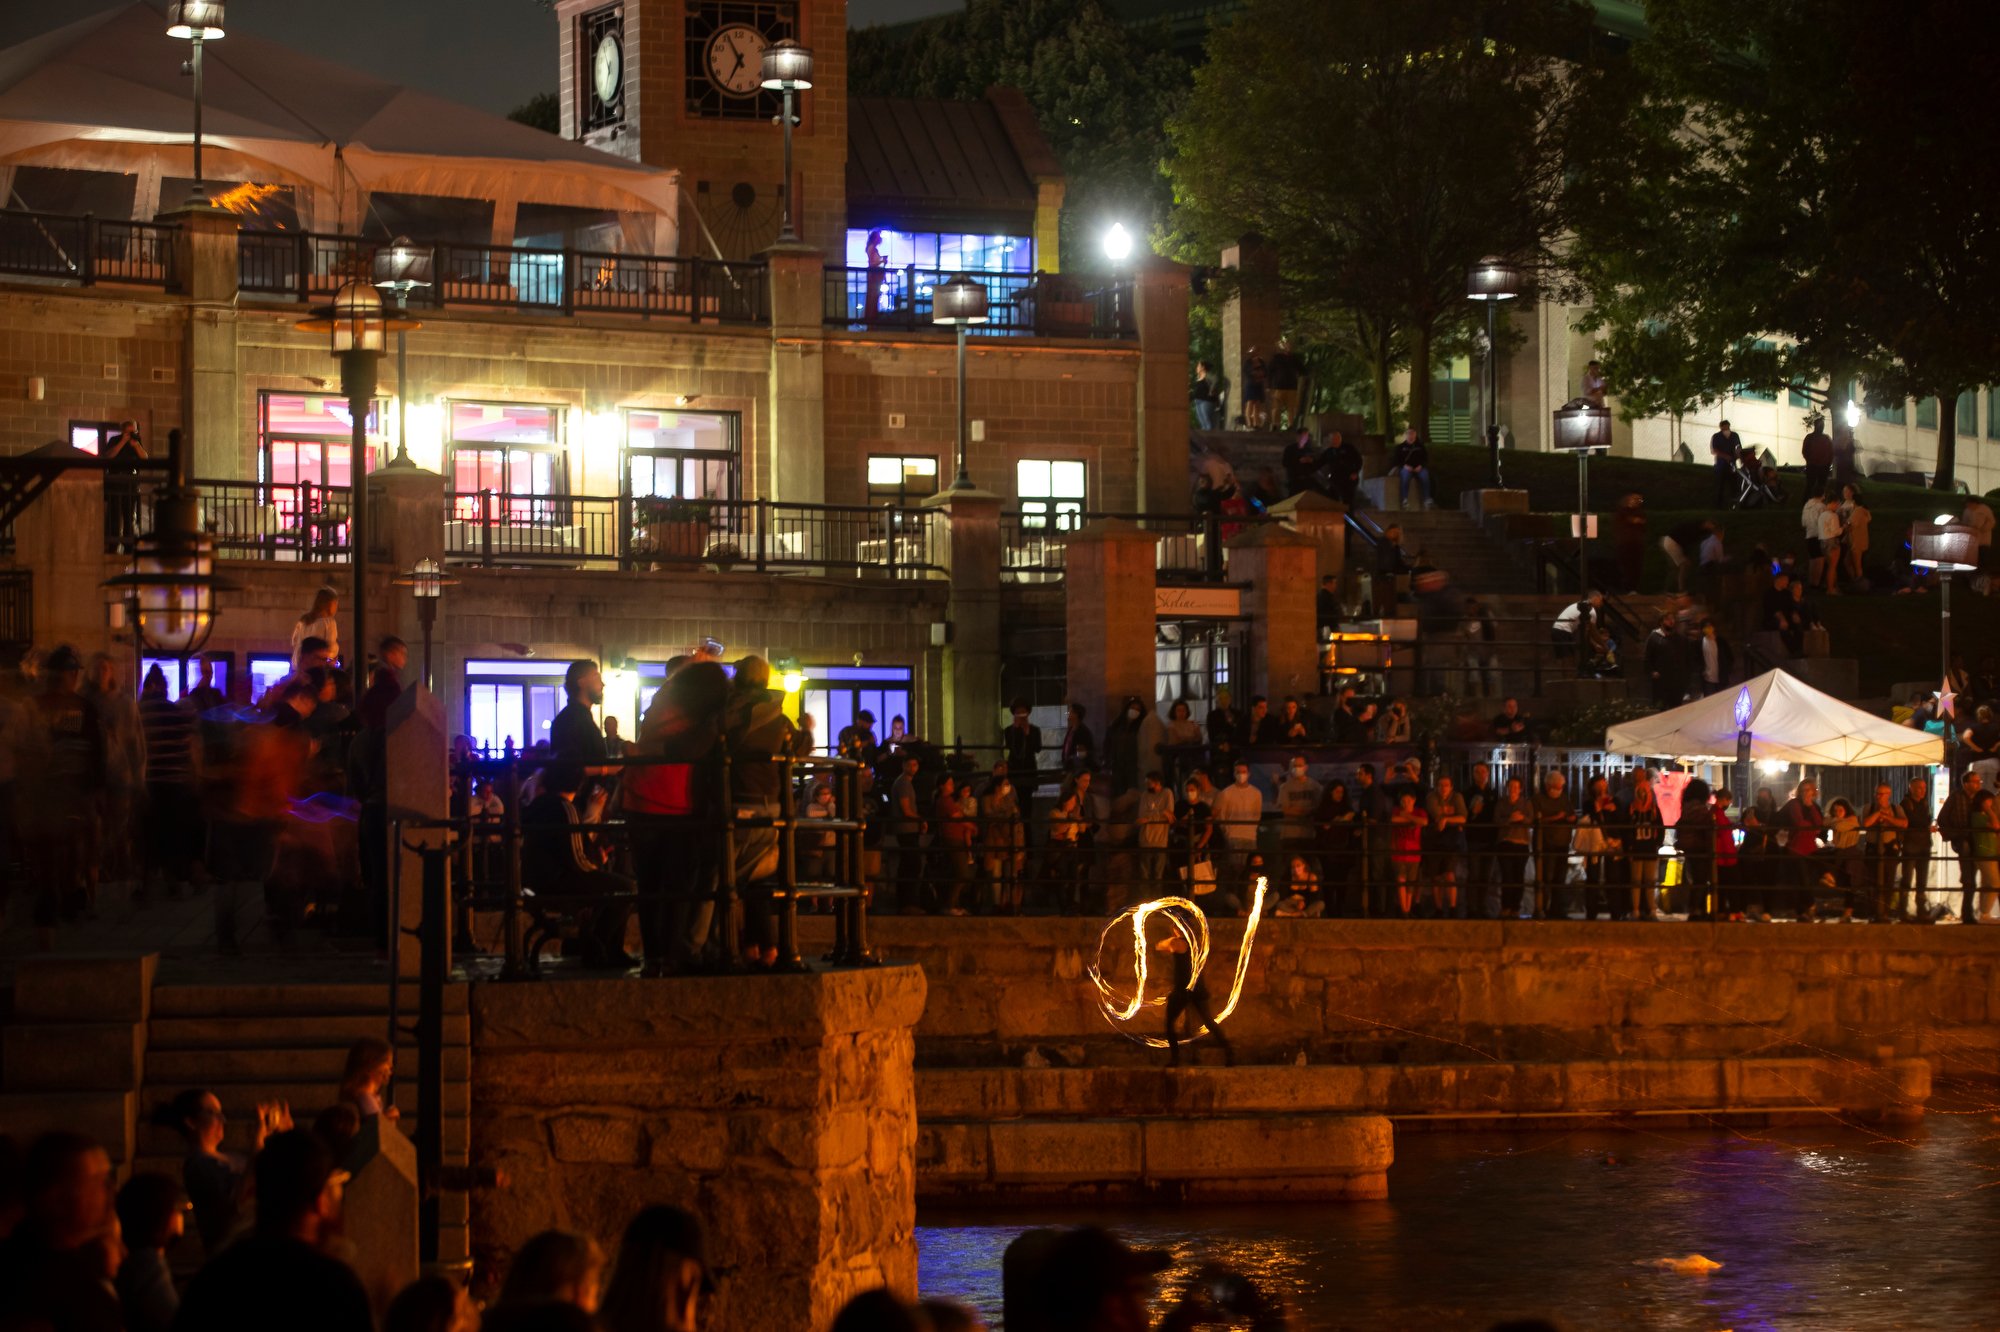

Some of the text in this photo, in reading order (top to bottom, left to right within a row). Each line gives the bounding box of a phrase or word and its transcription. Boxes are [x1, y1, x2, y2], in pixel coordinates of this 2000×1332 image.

[735, 31, 745, 39] 12
[715, 44, 725, 52] 10
[1155, 590, 1195, 610] Skyline
